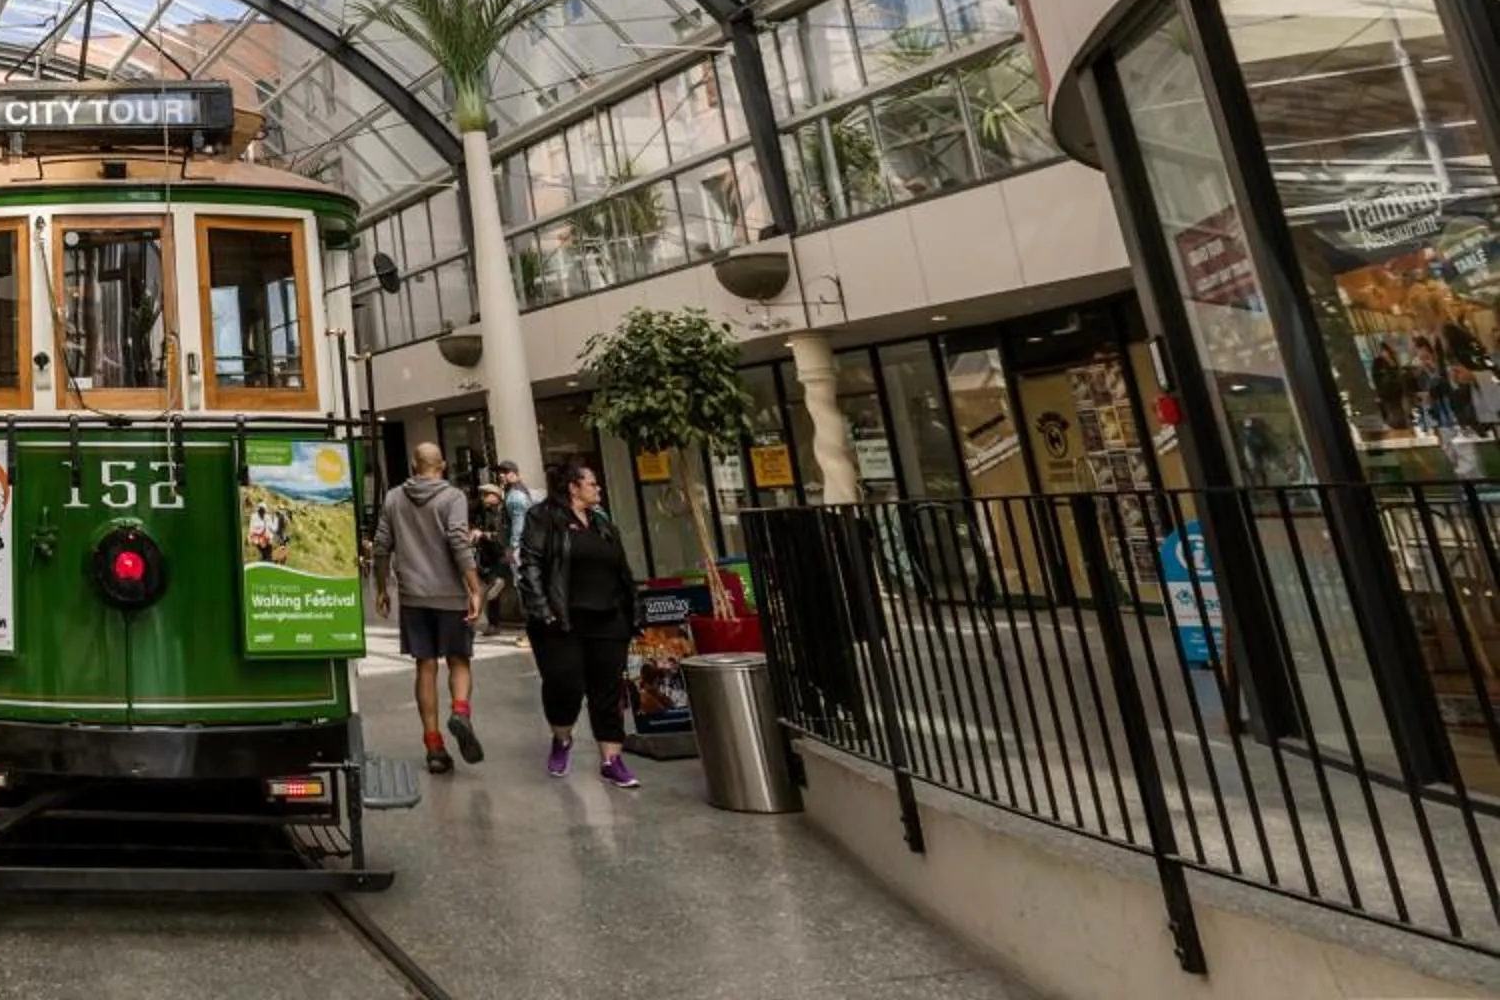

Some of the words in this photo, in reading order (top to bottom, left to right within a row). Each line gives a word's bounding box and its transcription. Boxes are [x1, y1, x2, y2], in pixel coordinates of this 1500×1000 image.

[5, 100, 82, 125] CITY
[89, 99, 184, 124] TOUR
[61, 460, 185, 508] 152
[252, 593, 301, 611] Walking
[304, 592, 356, 608] Festival
